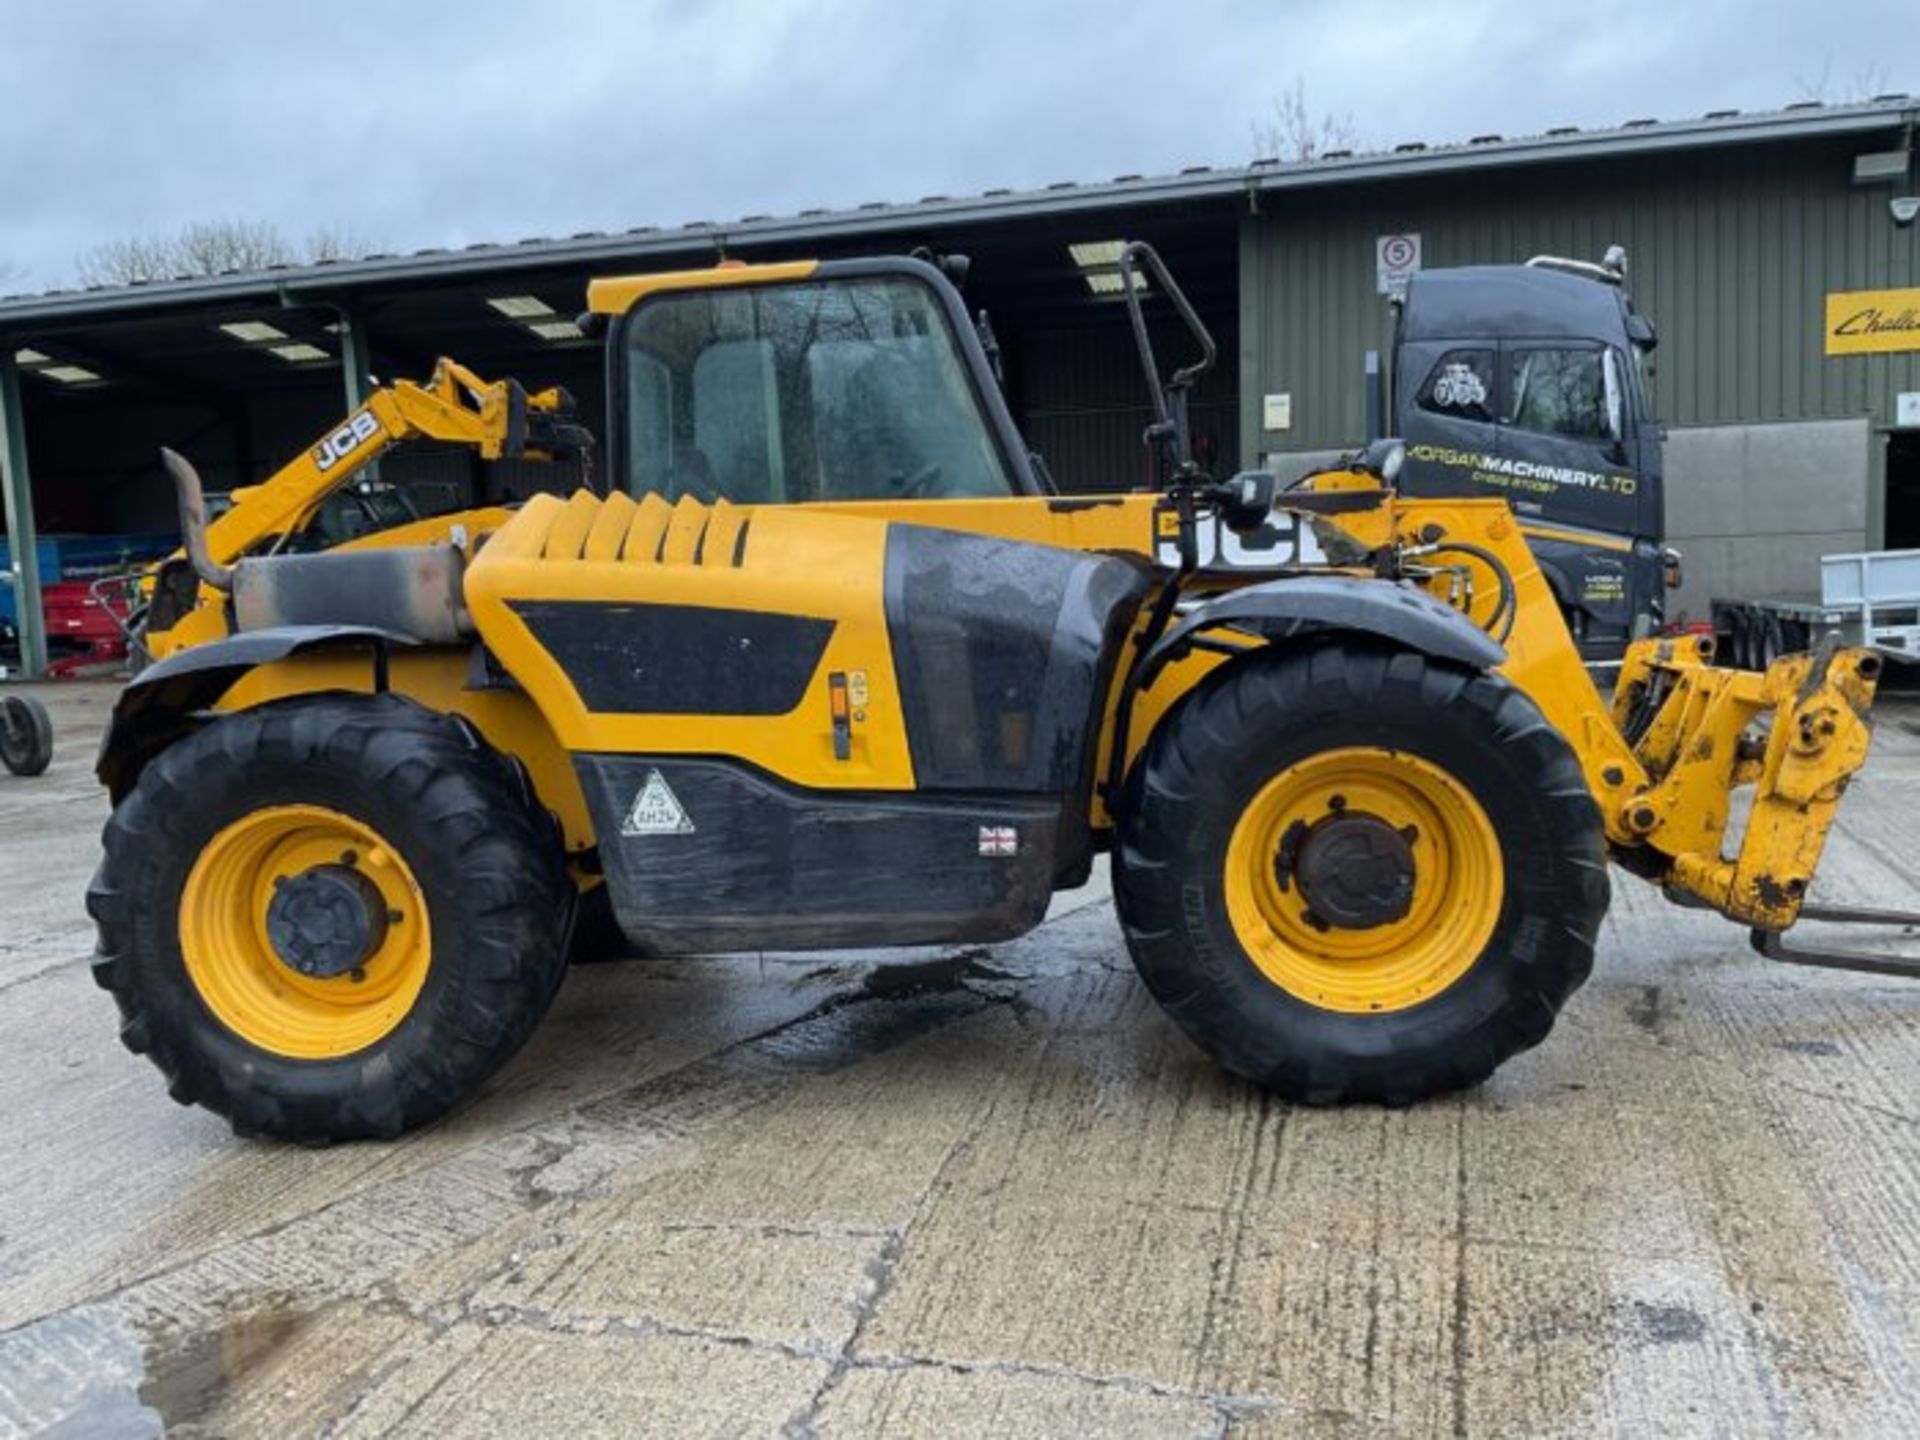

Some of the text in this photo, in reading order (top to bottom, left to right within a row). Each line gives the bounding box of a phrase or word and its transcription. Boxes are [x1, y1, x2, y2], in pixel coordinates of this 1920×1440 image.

[1393, 243, 1405, 261] 5
[1834, 307, 1920, 335] Challe
[317, 411, 378, 470] JCB
